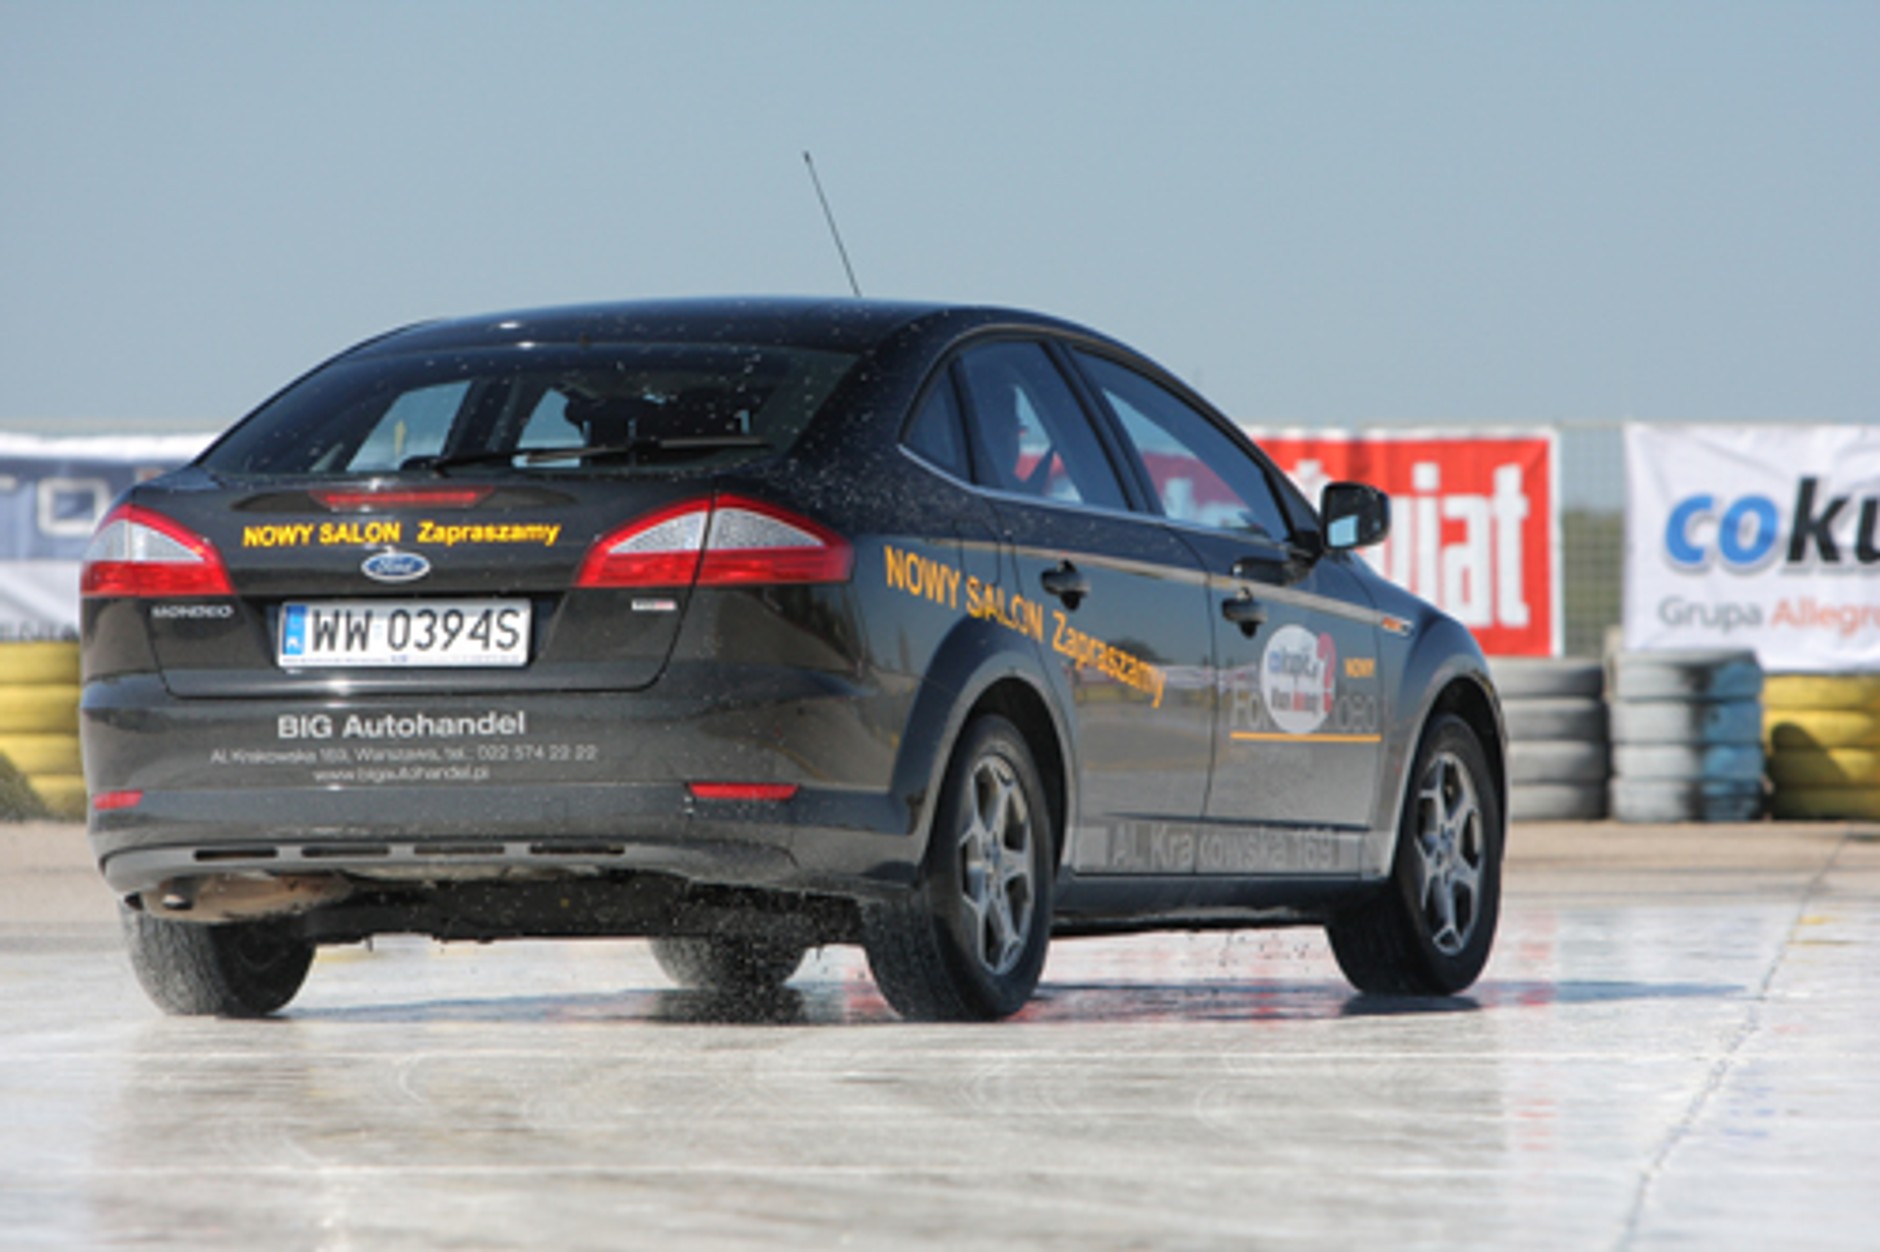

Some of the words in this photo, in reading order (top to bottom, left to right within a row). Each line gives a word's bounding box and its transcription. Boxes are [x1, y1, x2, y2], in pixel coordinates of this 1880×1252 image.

[243, 523, 313, 547] NOWY
[319, 521, 402, 545] SALON
[416, 519, 562, 547] Zapraszamy
[312, 608, 374, 652] WW
[387, 607, 521, 652] 0394S
[884, 545, 961, 610] NOWY
[965, 574, 1045, 645] SALON
[1052, 609, 1167, 709] Zapraszamy
[1657, 595, 1764, 635] Grupa
[276, 713, 334, 740] BIG
[341, 709, 526, 739] Autohandel
